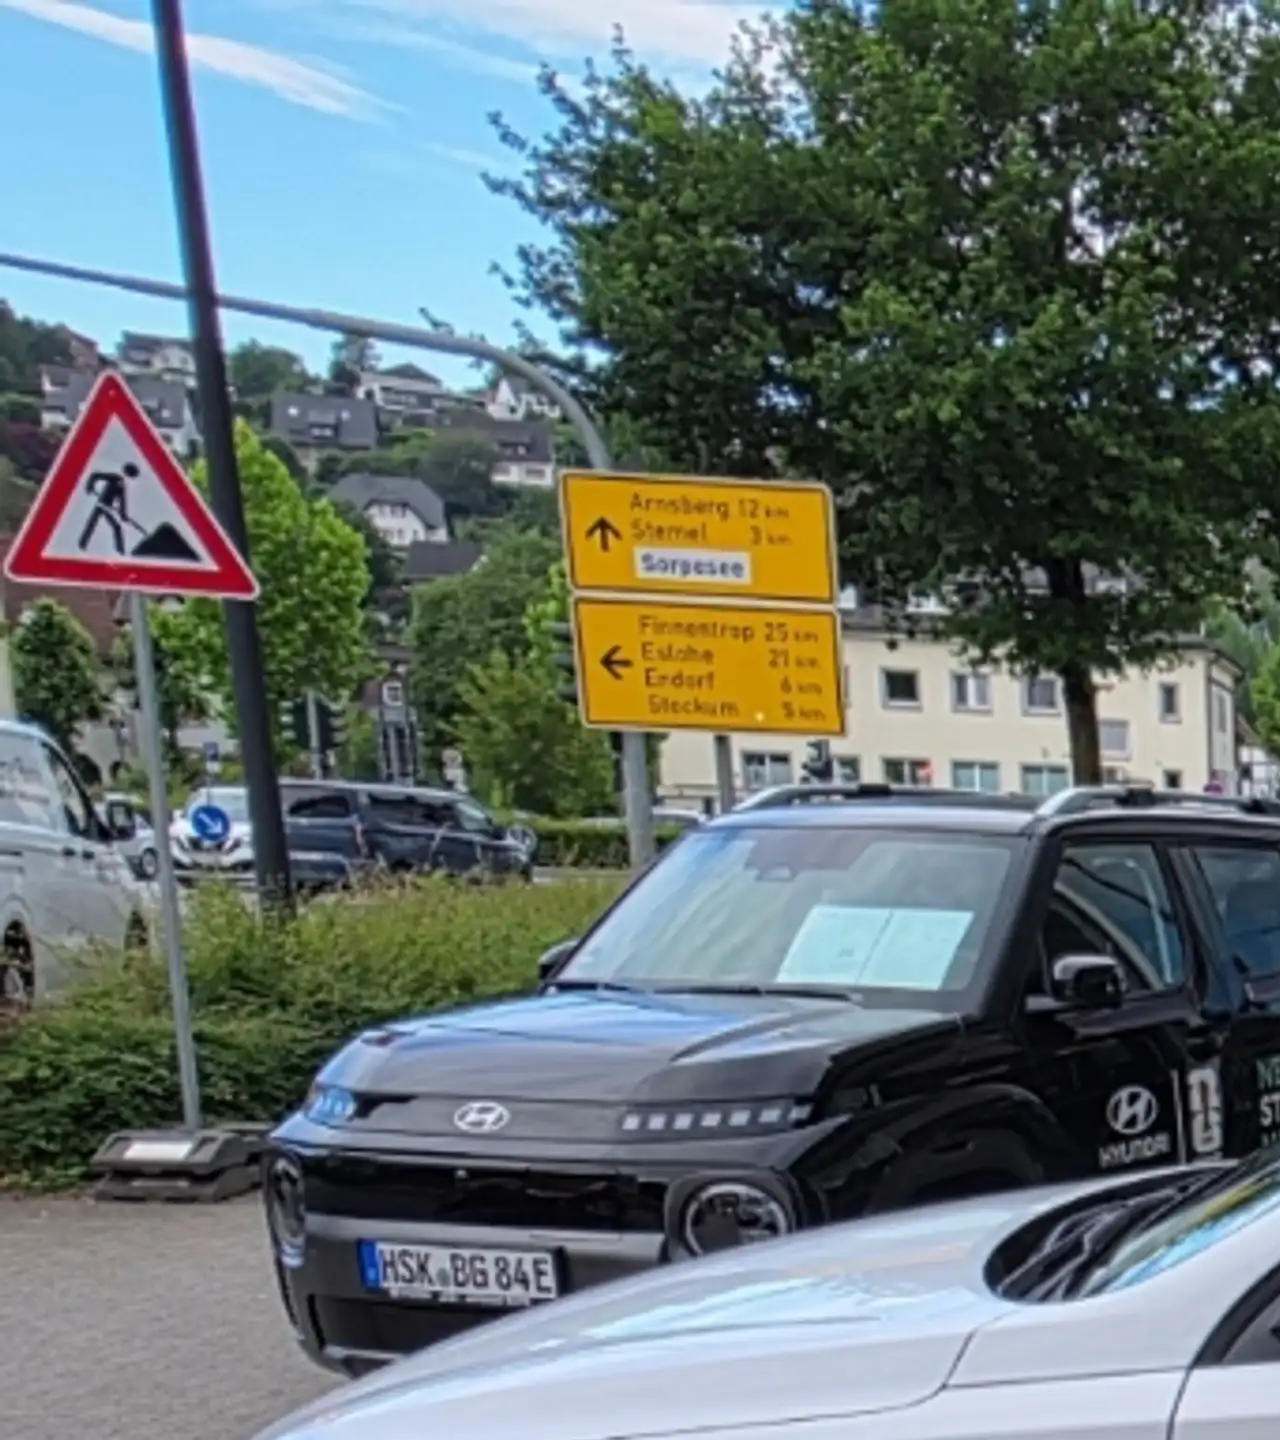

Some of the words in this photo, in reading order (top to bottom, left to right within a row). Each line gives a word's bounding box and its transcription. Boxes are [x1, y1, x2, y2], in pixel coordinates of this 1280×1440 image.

[630, 492, 729, 522] Arnsberg
[738, 498, 760, 518] 12
[765, 505, 789, 518] km
[749, 525, 762, 545] 3
[638, 615, 755, 643] Finnentrop
[764, 621, 788, 643] 25
[641, 641, 714, 664] Eslohe
[768, 648, 790, 668] 21
[644, 667, 715, 690] Endorf
[780, 675, 792, 694] 6
[799, 707, 826, 720] km
[1100, 1133, 1170, 1168] HYUNDAI
[380, 1249, 435, 1286] HSK
[450, 1252, 489, 1289] BG
